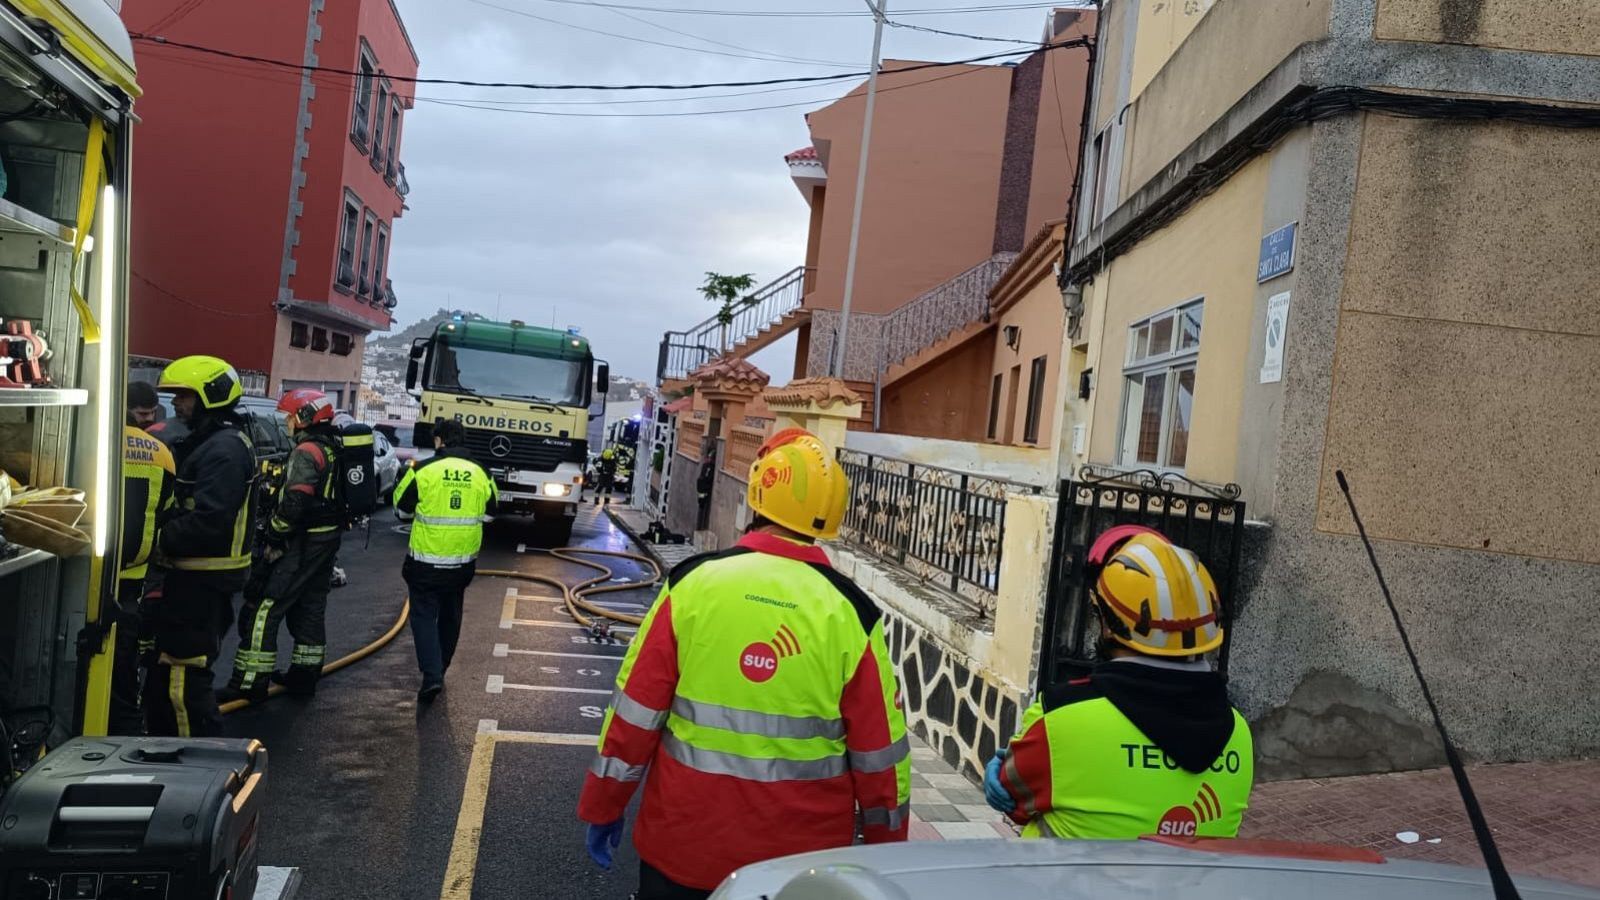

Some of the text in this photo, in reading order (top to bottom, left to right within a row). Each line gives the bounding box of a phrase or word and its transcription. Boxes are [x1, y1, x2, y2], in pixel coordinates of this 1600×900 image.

[1269, 229, 1285, 245] CALLE
[1258, 249, 1290, 279] SANTA CLARA
[453, 412, 553, 433] BOMBEROS
[743, 654, 776, 670] SUC
[1120, 744, 1240, 774] TECCO
[1159, 820, 1196, 836] SUC
